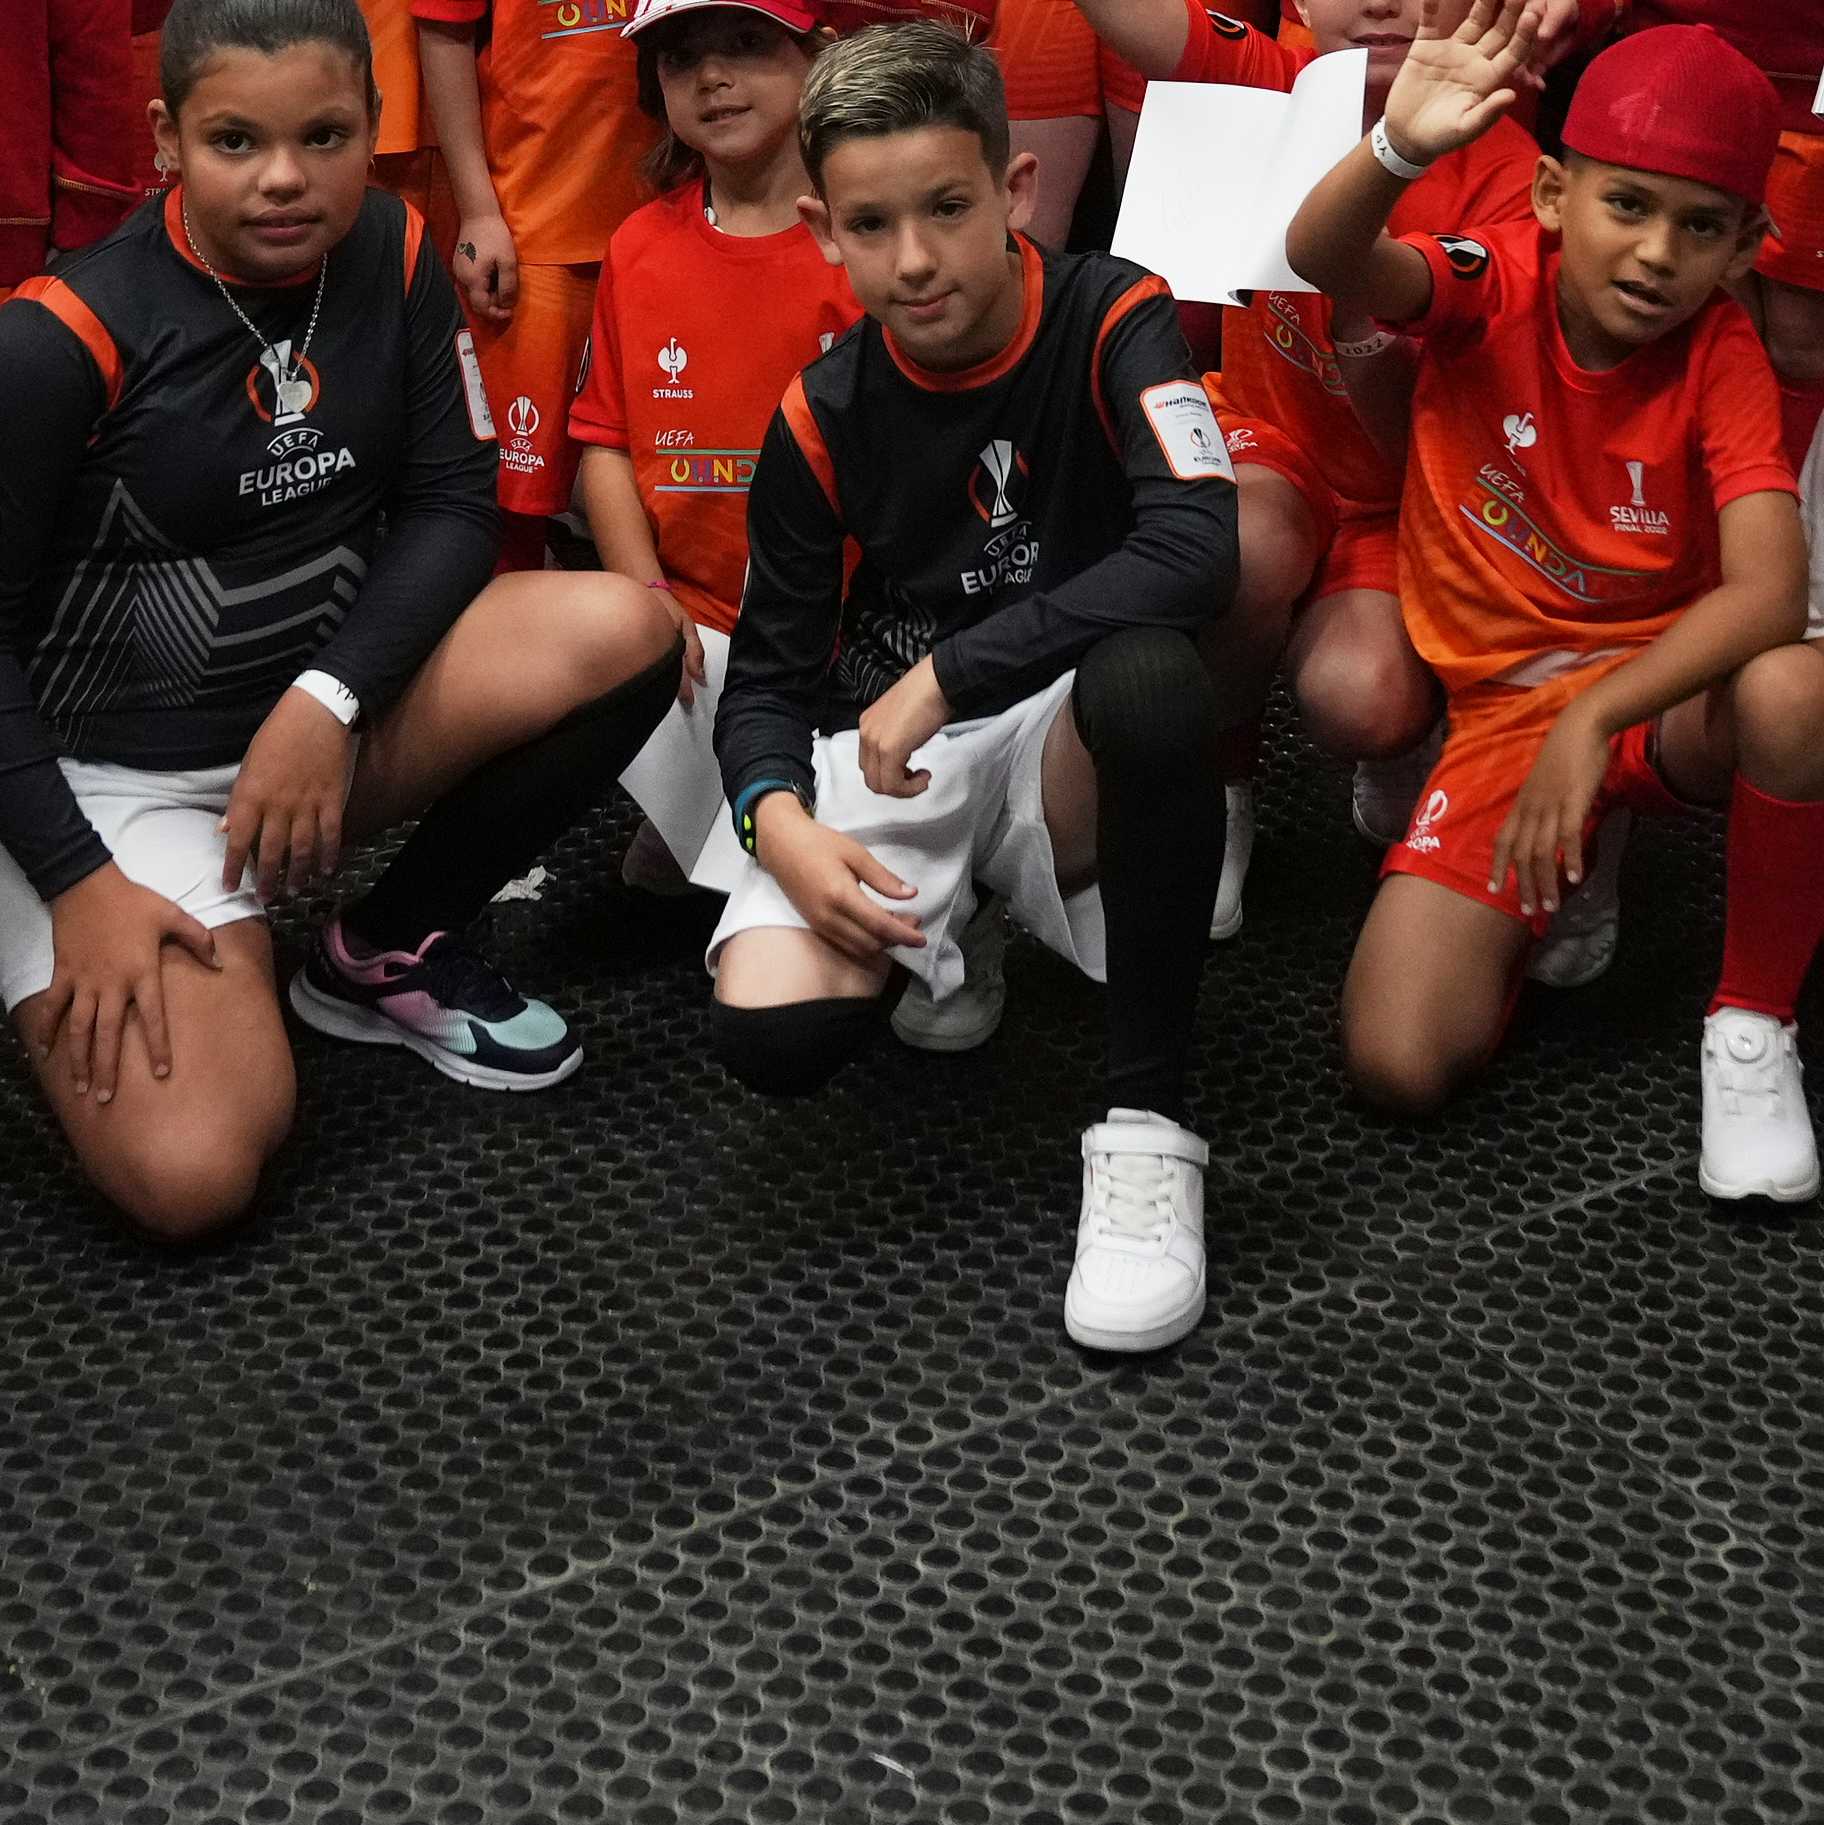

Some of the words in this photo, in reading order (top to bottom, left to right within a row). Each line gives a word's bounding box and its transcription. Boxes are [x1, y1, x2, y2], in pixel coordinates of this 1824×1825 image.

[1345, 338, 1384, 355] 2022
[653, 389, 694, 399] STRAUSS
[270, 432, 319, 457] UEFA
[511, 439, 531, 452] UEFA
[654, 430, 694, 446] UEFA
[500, 449, 545, 467] EUROPA
[238, 447, 357, 495] EUROPA
[506, 462, 534, 474] LEAGUE
[261, 476, 333, 507] LEAGUE
[1479, 463, 1525, 504] UEFA
[1614, 524, 1642, 533] FINAL
[1644, 525, 1669, 534] 2022
[960, 541, 1040, 595] EUROP
